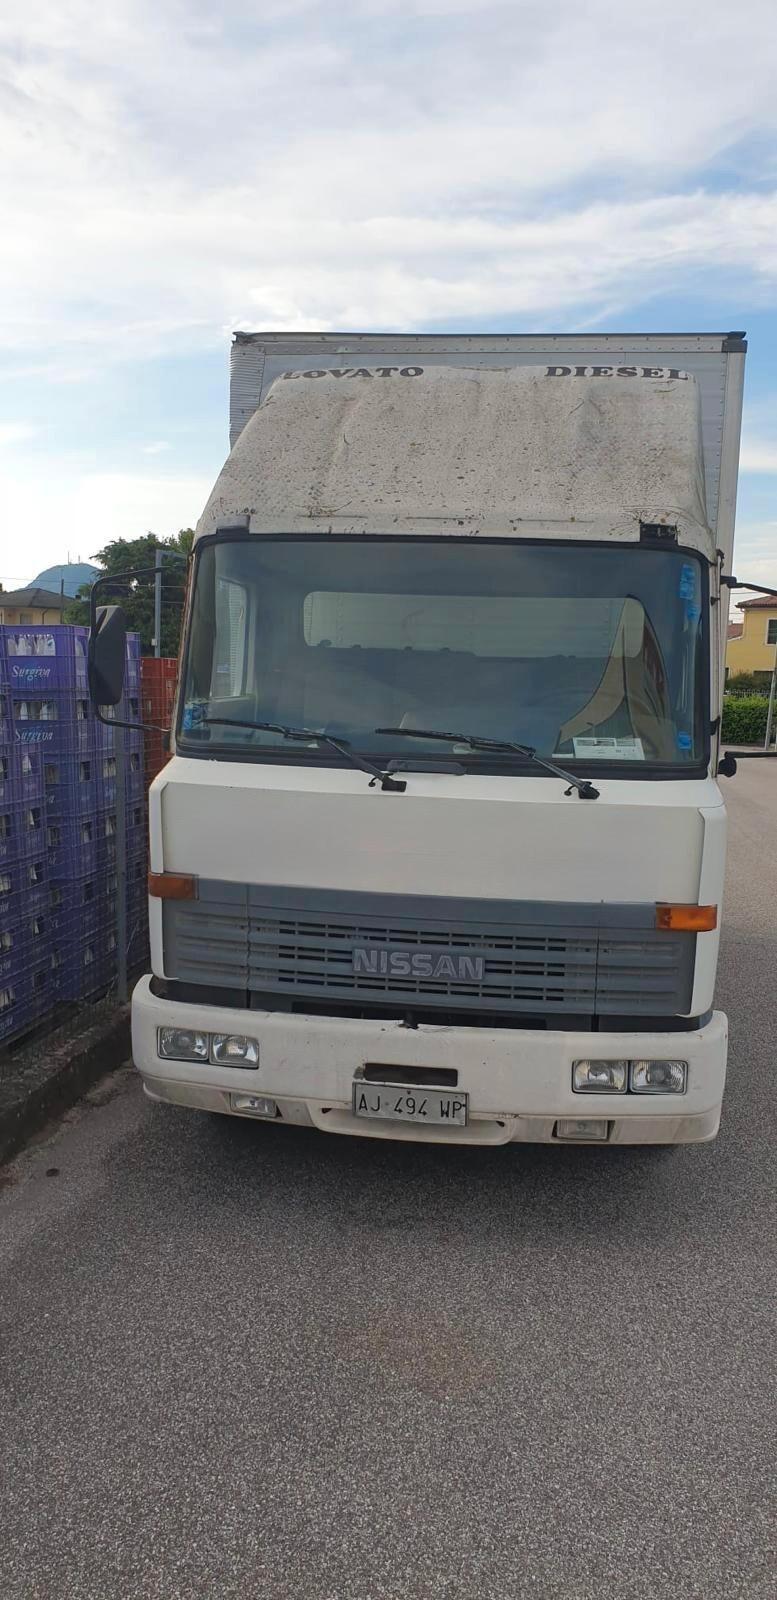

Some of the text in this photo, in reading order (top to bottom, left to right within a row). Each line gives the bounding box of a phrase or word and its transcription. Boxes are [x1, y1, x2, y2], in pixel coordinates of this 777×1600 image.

[283, 366, 689, 381] LOVATO DIESEL
[352, 948, 484, 981] NISSAN
[358, 1093, 463, 1119] AJ 494 WP
